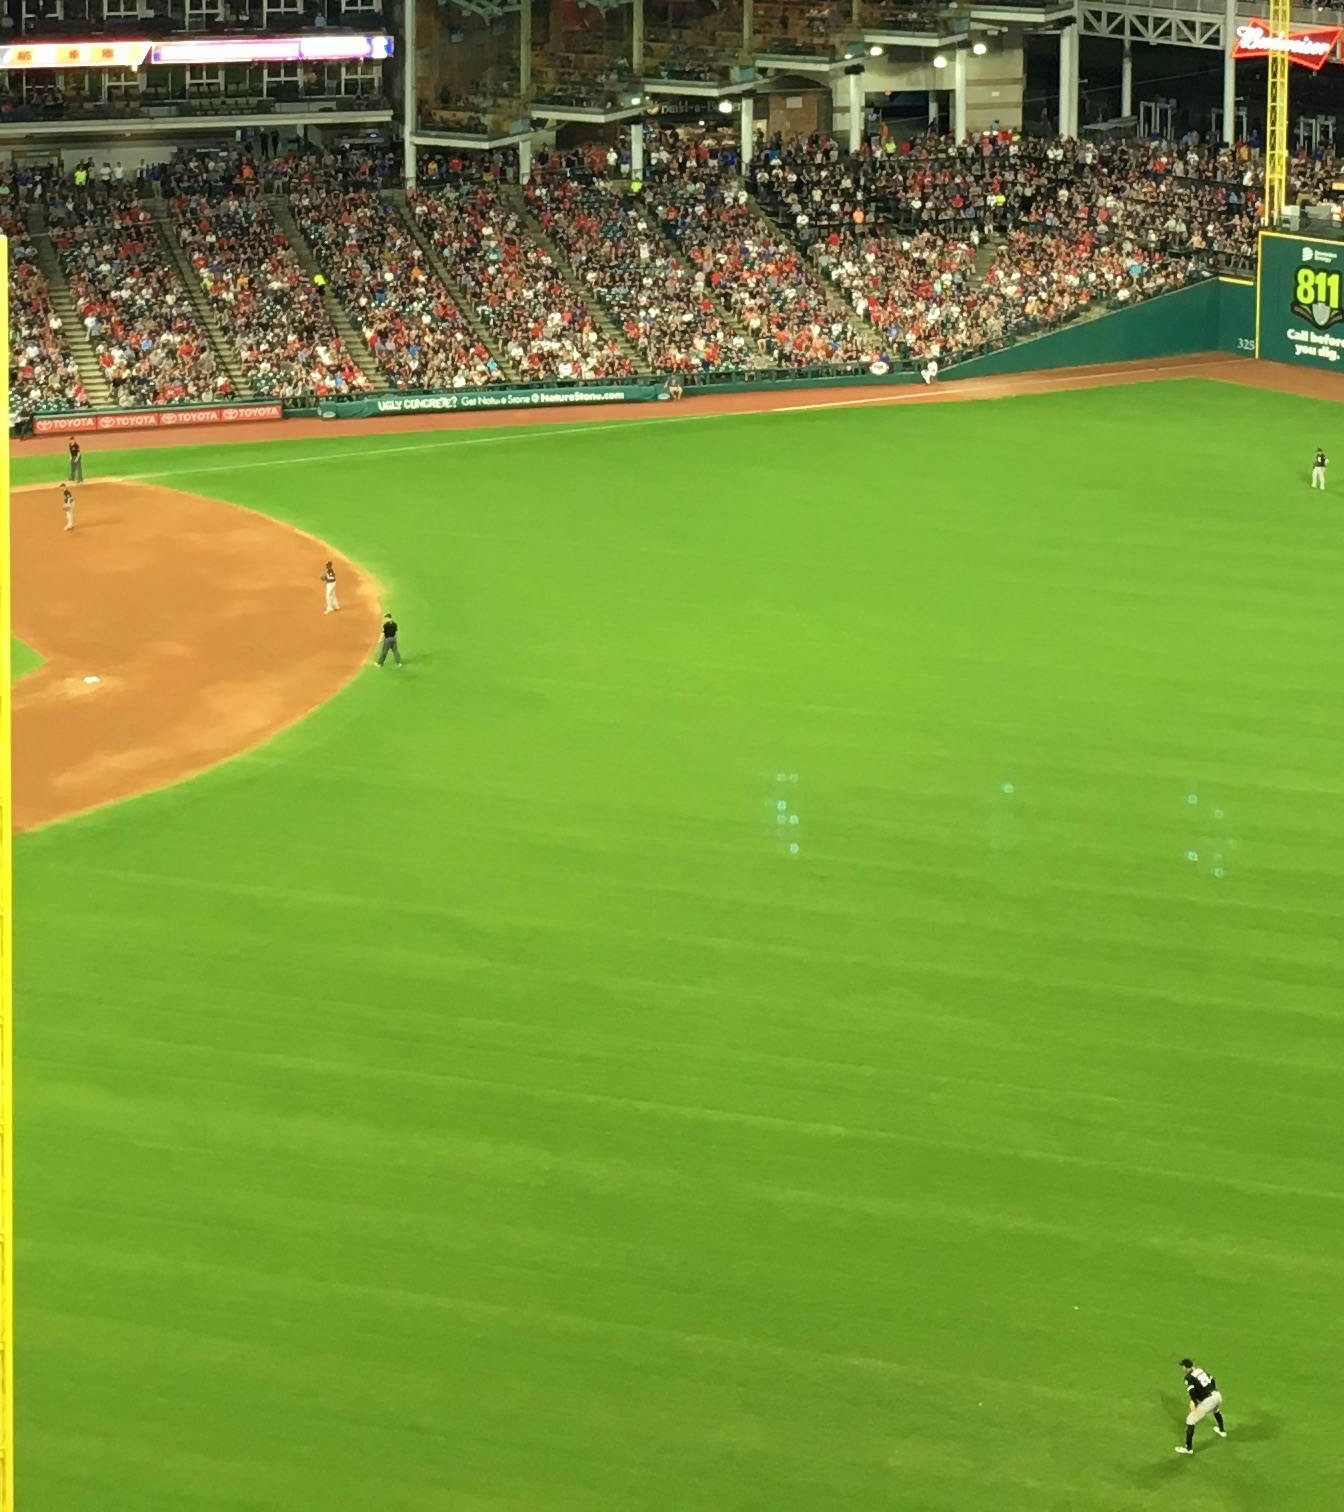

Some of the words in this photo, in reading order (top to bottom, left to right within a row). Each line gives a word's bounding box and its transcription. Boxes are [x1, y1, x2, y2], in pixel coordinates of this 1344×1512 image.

[1297, 268, 1340, 309] 811
[1287, 329, 1309, 342] Call
[1237, 338, 1256, 352] 325
[1295, 345, 1317, 356] you
[1318, 346, 1341, 362] dig.
[378, 400, 403, 411] UGLY
[403, 397, 457, 409] CONCRETE?
[461, 396, 476, 405] Get
[531, 393, 540, 403] @
[178, 412, 218, 421] TOYOTA
[238, 407, 279, 416] TOYOTA
[54, 419, 94, 428] TOYOTA
[116, 415, 155, 425] TOYOTA
